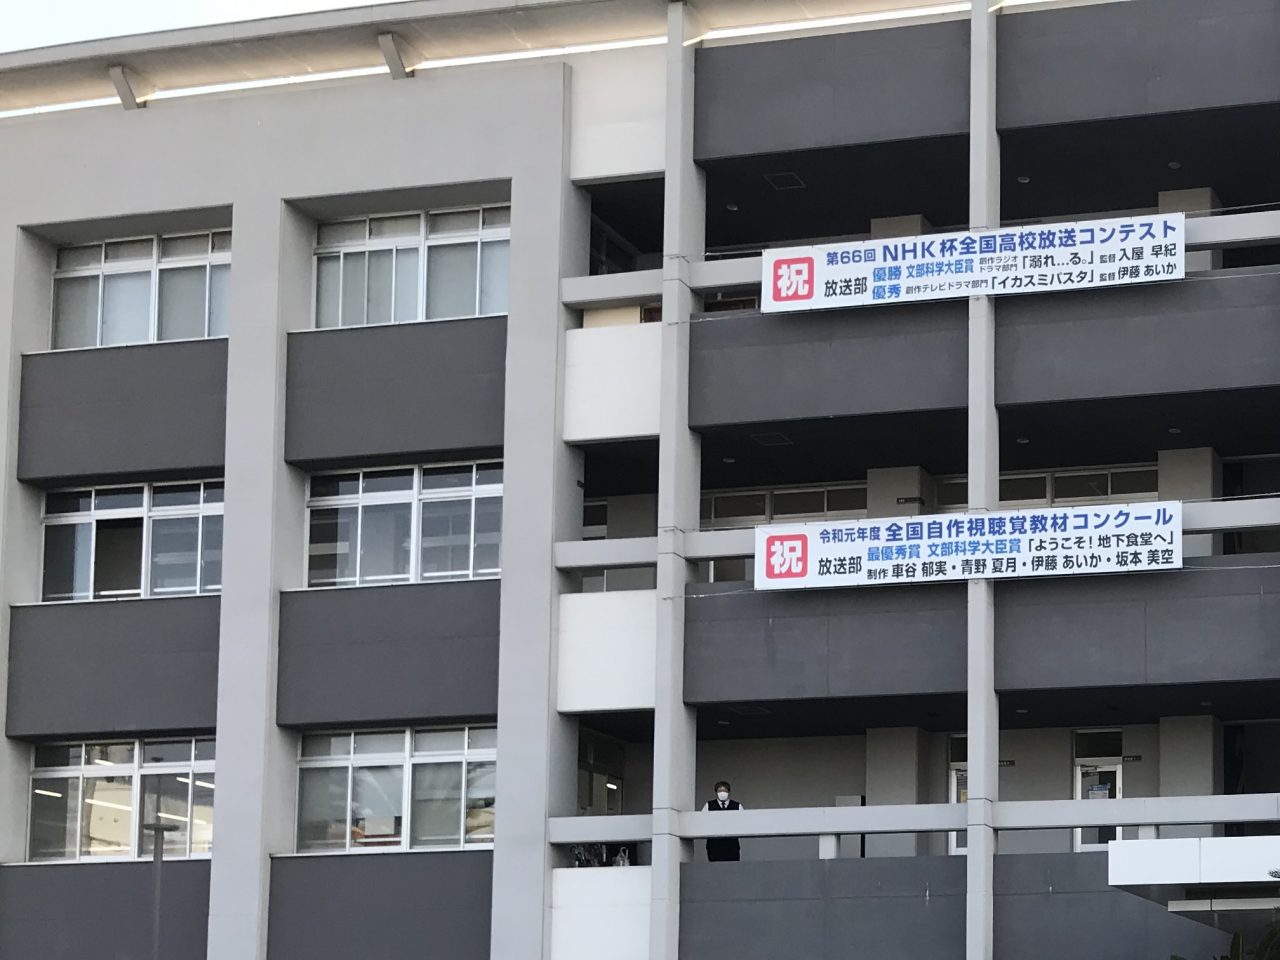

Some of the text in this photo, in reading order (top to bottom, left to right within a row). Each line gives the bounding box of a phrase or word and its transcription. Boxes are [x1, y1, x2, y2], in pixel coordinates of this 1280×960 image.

[826, 249, 876, 266] 第66回
[1150, 243, 1177, 258] 早紀
[777, 262, 810, 297] 祝
[872, 284, 902, 300] 優秀
[1118, 265, 1140, 280] 伊藤
[1144, 262, 1177, 277] あいか
[873, 258, 974, 282] 優勝 文部科学大臣賞
[824, 277, 868, 297] 放送部
[819, 508, 1174, 544] 令和元年度 全国自作視聴覚教材コンクール
[770, 540, 803, 575] 祝
[867, 544, 921, 561] 最優秀賞
[927, 538, 1022, 558] 文部科学大臣賞
[818, 556, 863, 576] 放送部
[867, 568, 889, 580] 制作
[891, 562, 917, 578] 車谷
[1147, 549, 1175, 566] 美空
